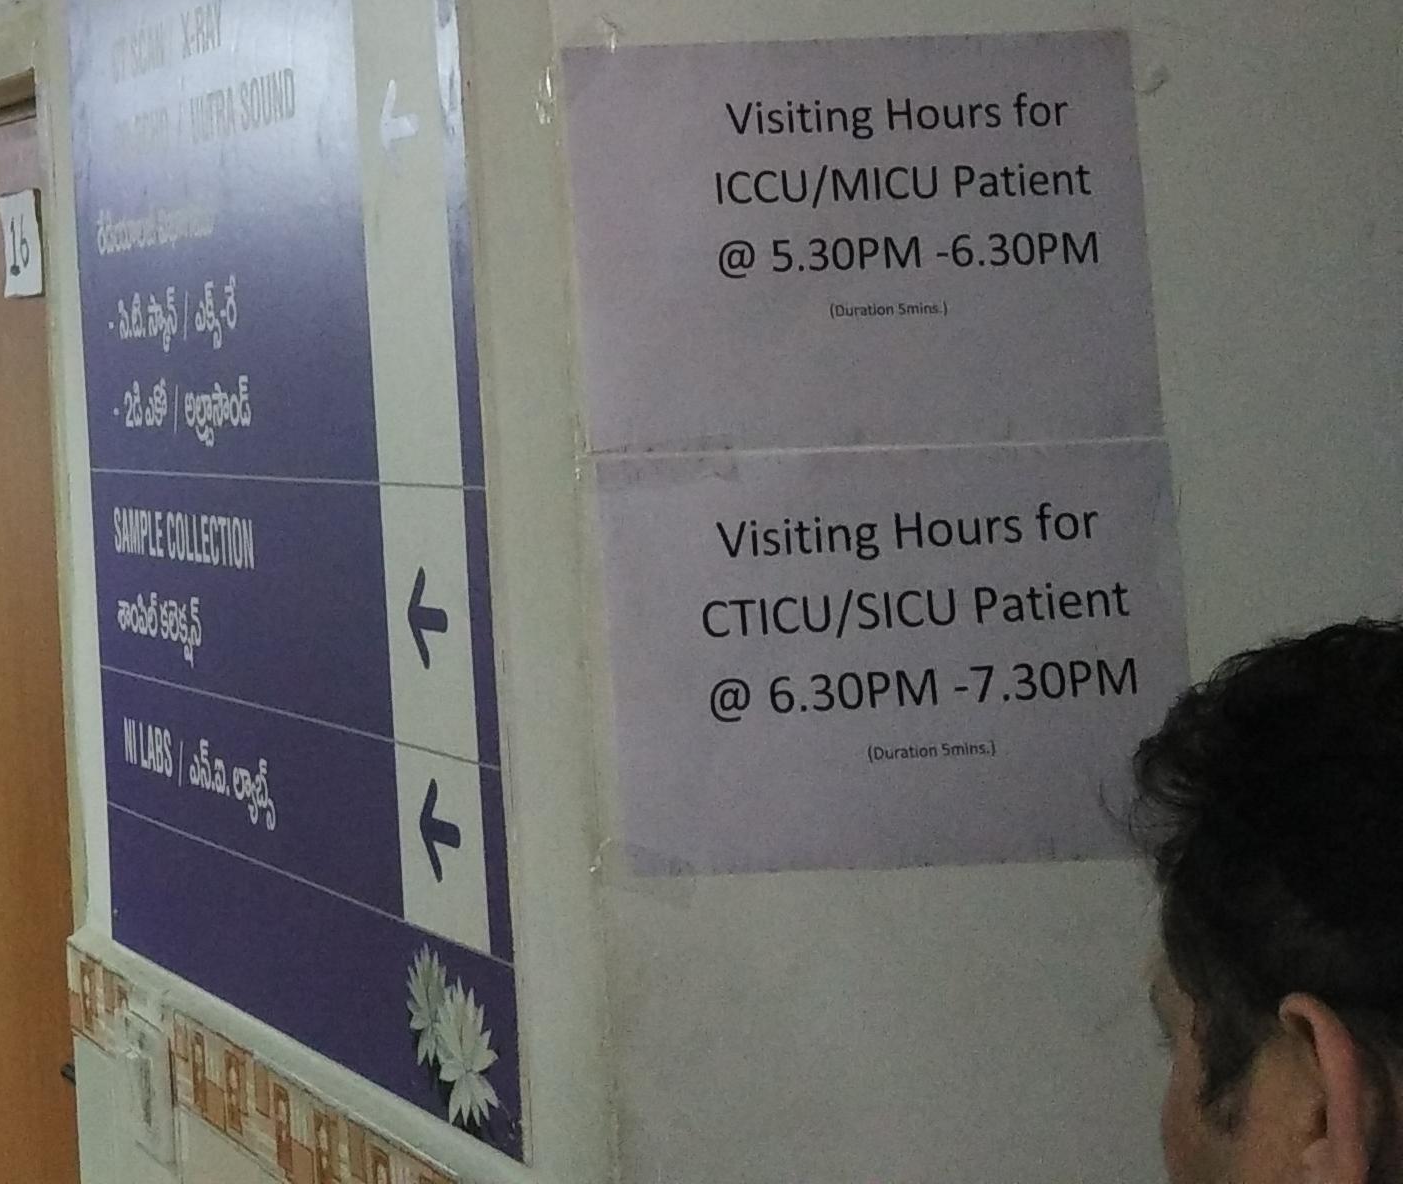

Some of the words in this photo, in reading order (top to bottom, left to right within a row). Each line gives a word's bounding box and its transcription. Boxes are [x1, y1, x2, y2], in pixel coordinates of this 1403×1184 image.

[239, 68, 295, 131] SOUND
[726, 98, 873, 139] Visiting
[887, 97, 1001, 131] Hours
[1013, 92, 1068, 128] for
[715, 165, 938, 209] ICCU/MICU
[955, 163, 1091, 199] Patient
[719, 240, 755, 278] @
[773, 235, 922, 273] 5.30PM
[830, 303, 894, 319] (Duration
[898, 300, 948, 317] 5mins.)
[113, 507, 164, 557] SAMPLE
[166, 511, 255, 570] COLLECTION
[716, 516, 879, 561] Visiting
[895, 510, 1023, 550] Hours
[1036, 503, 1099, 543] for
[702, 588, 956, 639] CTICU/SICU
[975, 580, 1131, 624] Patient
[710, 679, 751, 722] @
[769, 668, 939, 714] 6.30PM
[124, 717, 137, 765] NI
[139, 722, 173, 778] LABS
[867, 745, 937, 763] (Duration
[942, 740, 996, 757] 5mins.)
